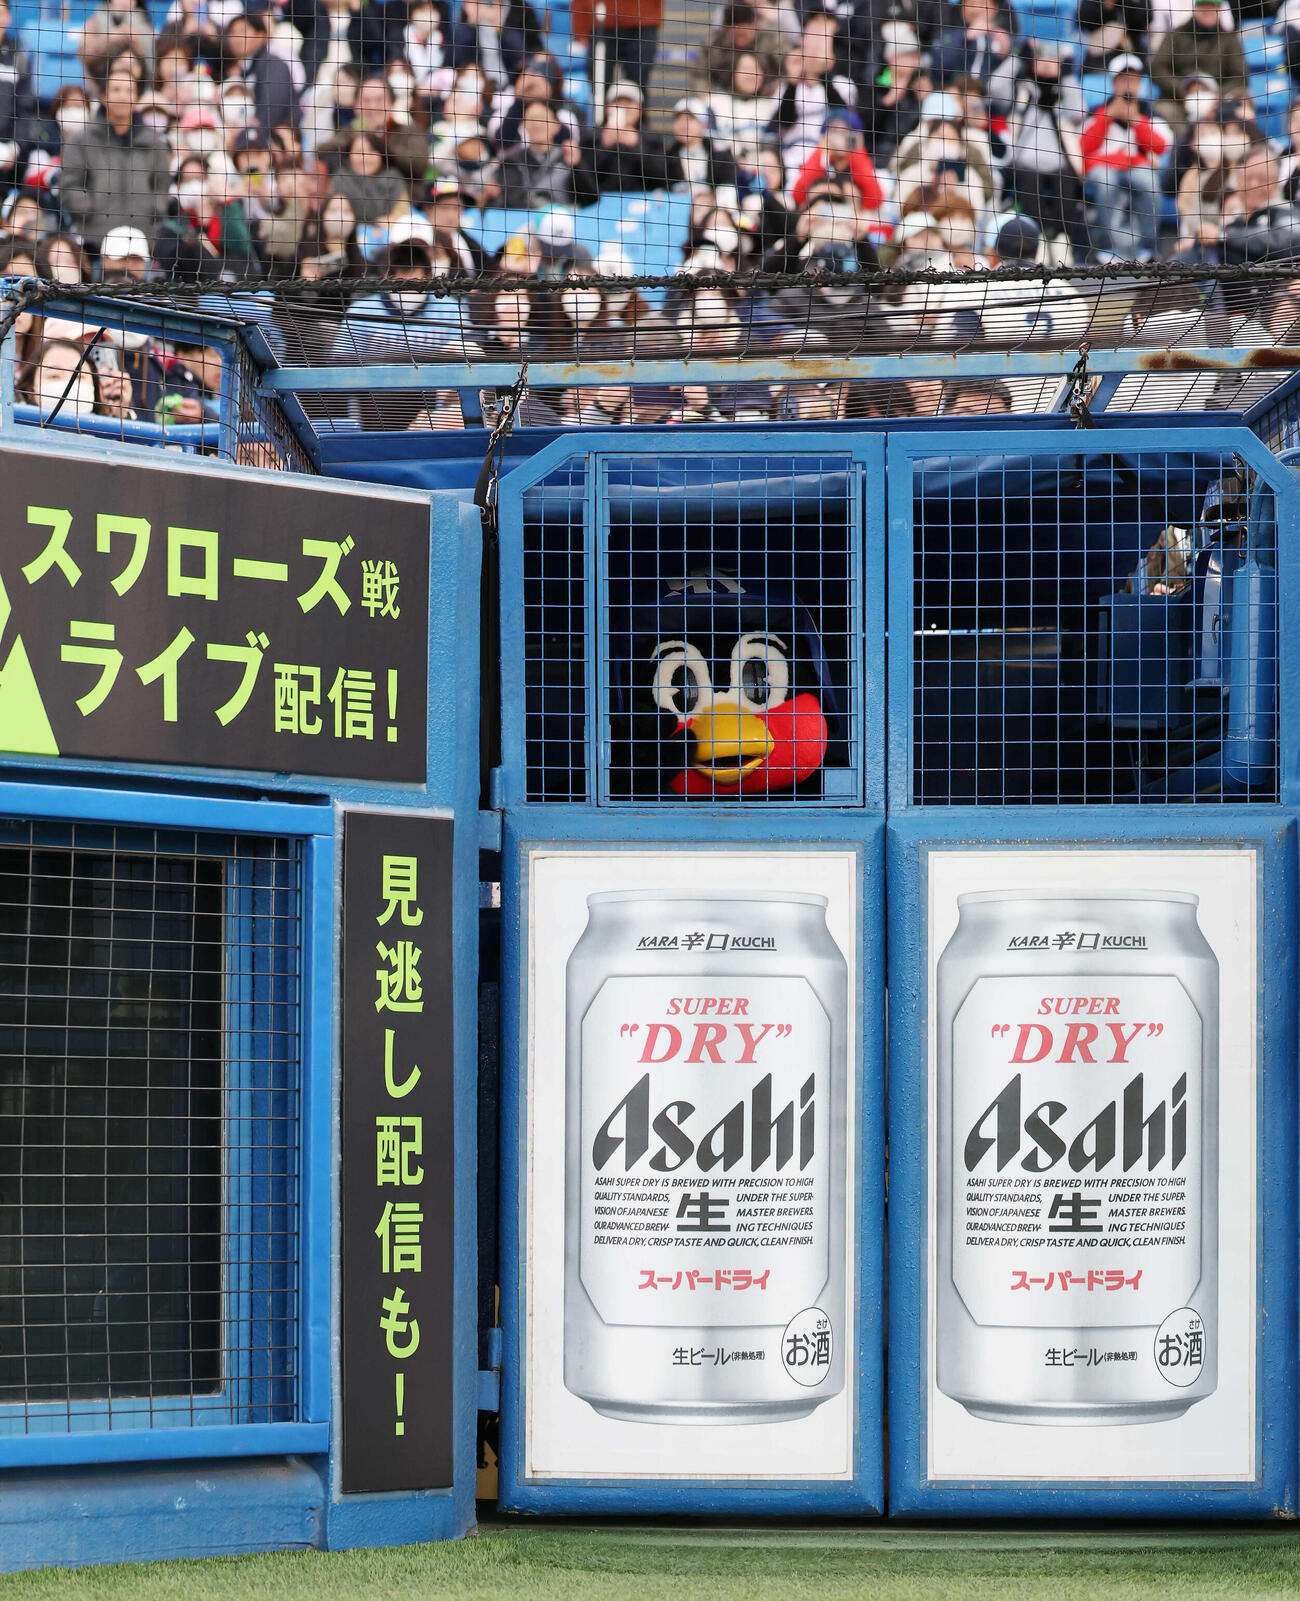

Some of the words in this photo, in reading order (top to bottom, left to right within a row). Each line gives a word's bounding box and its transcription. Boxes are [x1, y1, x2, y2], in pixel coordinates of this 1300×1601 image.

[21, 505, 400, 619] スワローズ戦
[60, 625, 399, 743] ライブ配信!
[638, 936, 678, 948] KARA
[680, 932, 729, 950] 辛口
[731, 937, 775, 948] KUCHI
[1009, 936, 1049, 947] KARA
[1051, 931, 1100, 950] 辛口
[1102, 936, 1146, 947] KUCHI
[666, 998, 749, 1015] SUPER
[1038, 997, 1121, 1015] SUPER
[592, 1072, 815, 1173] Asahi
[964, 1072, 1187, 1172] Asahi
[374, 854, 424, 1436] 見逃し配信も!
[595, 1177, 614, 1186] ASAHI
[616, 1178, 640, 1186] SUPER
[642, 1178, 659, 1186] DRY
[661, 1179, 669, 1187] IS
[671, 1179, 709, 1187] BREWED
[712, 1179, 736, 1187] WITH
[739, 1178, 783, 1187] PRECISION
[786, 1178, 796, 1186] TO
[796, 1178, 814, 1186] HIGH
[967, 1178, 986, 1187] ASAHI
[988, 1179, 1012, 1187] SUPER
[1014, 1179, 1031, 1187] DRY
[1033, 1179, 1041, 1187] IS
[1043, 1179, 1081, 1187] BREWED
[1084, 1179, 1108, 1187] WITH
[1111, 1178, 1155, 1187] PRECISION
[1158, 1178, 1168, 1186] TO
[1168, 1177, 1186, 1186] HIGH
[594, 1192, 621, 1201] QUALITY
[621, 1193, 671, 1202] STANDARDS,
[736, 1193, 769, 1202] UNDER
[771, 1193, 787, 1202] THE
[966, 1193, 993, 1202] QUALITY
[993, 1194, 1043, 1203] STANDARDS,
[1108, 1193, 1141, 1202] UNDER
[1143, 1193, 1159, 1201] THE
[594, 1207, 618, 1215] VISION
[626, 1208, 669, 1217] JAPANESE
[736, 1208, 775, 1217] MASTER
[676, 1192, 731, 1232] 生
[966, 1208, 990, 1216] VISION
[989, 1208, 999, 1216] OF
[998, 1209, 1041, 1217] JAPANESE
[1108, 1208, 1147, 1217] MASTER
[1048, 1192, 1103, 1232] 生
[594, 1222, 608, 1230] OUR
[607, 1222, 645, 1230] ADVANCED
[736, 1223, 756, 1232] ING
[757, 1222, 813, 1231] TECHNIQUES
[966, 1223, 980, 1231] OUR
[979, 1223, 1017, 1231] ADVANCED
[1108, 1223, 1128, 1232] ING
[1129, 1222, 1185, 1231] TECHNIQUES
[594, 1236, 623, 1245] DELIVER
[622, 1237, 629, 1245] A
[629, 1238, 647, 1247] DRY,
[647, 1238, 673, 1246] CRISP
[674, 1238, 702, 1247] TASTE
[703, 1238, 726, 1246] AND
[727, 1238, 759, 1247] QUICK,
[760, 1238, 788, 1246] CLEAN
[966, 1237, 995, 1246] DELIVER
[994, 1238, 1001, 1246] A
[1001, 1239, 1019, 1248] DRY,
[1019, 1238, 1045, 1247] CRISP
[1046, 1239, 1075, 1247] TASTE
[1075, 1238, 1098, 1247] AND
[1100, 1238, 1132, 1247] QUICK,
[1132, 1238, 1160, 1246] CLEAN
[638, 1269, 770, 1291] スーパードライ
[1010, 1270, 1143, 1291] スーパードライ
[816, 1319, 828, 1329] さけ
[1189, 1319, 1200, 1329] さけ
[786, 1330, 830, 1366] お酒
[1158, 1331, 1203, 1366] お酒
